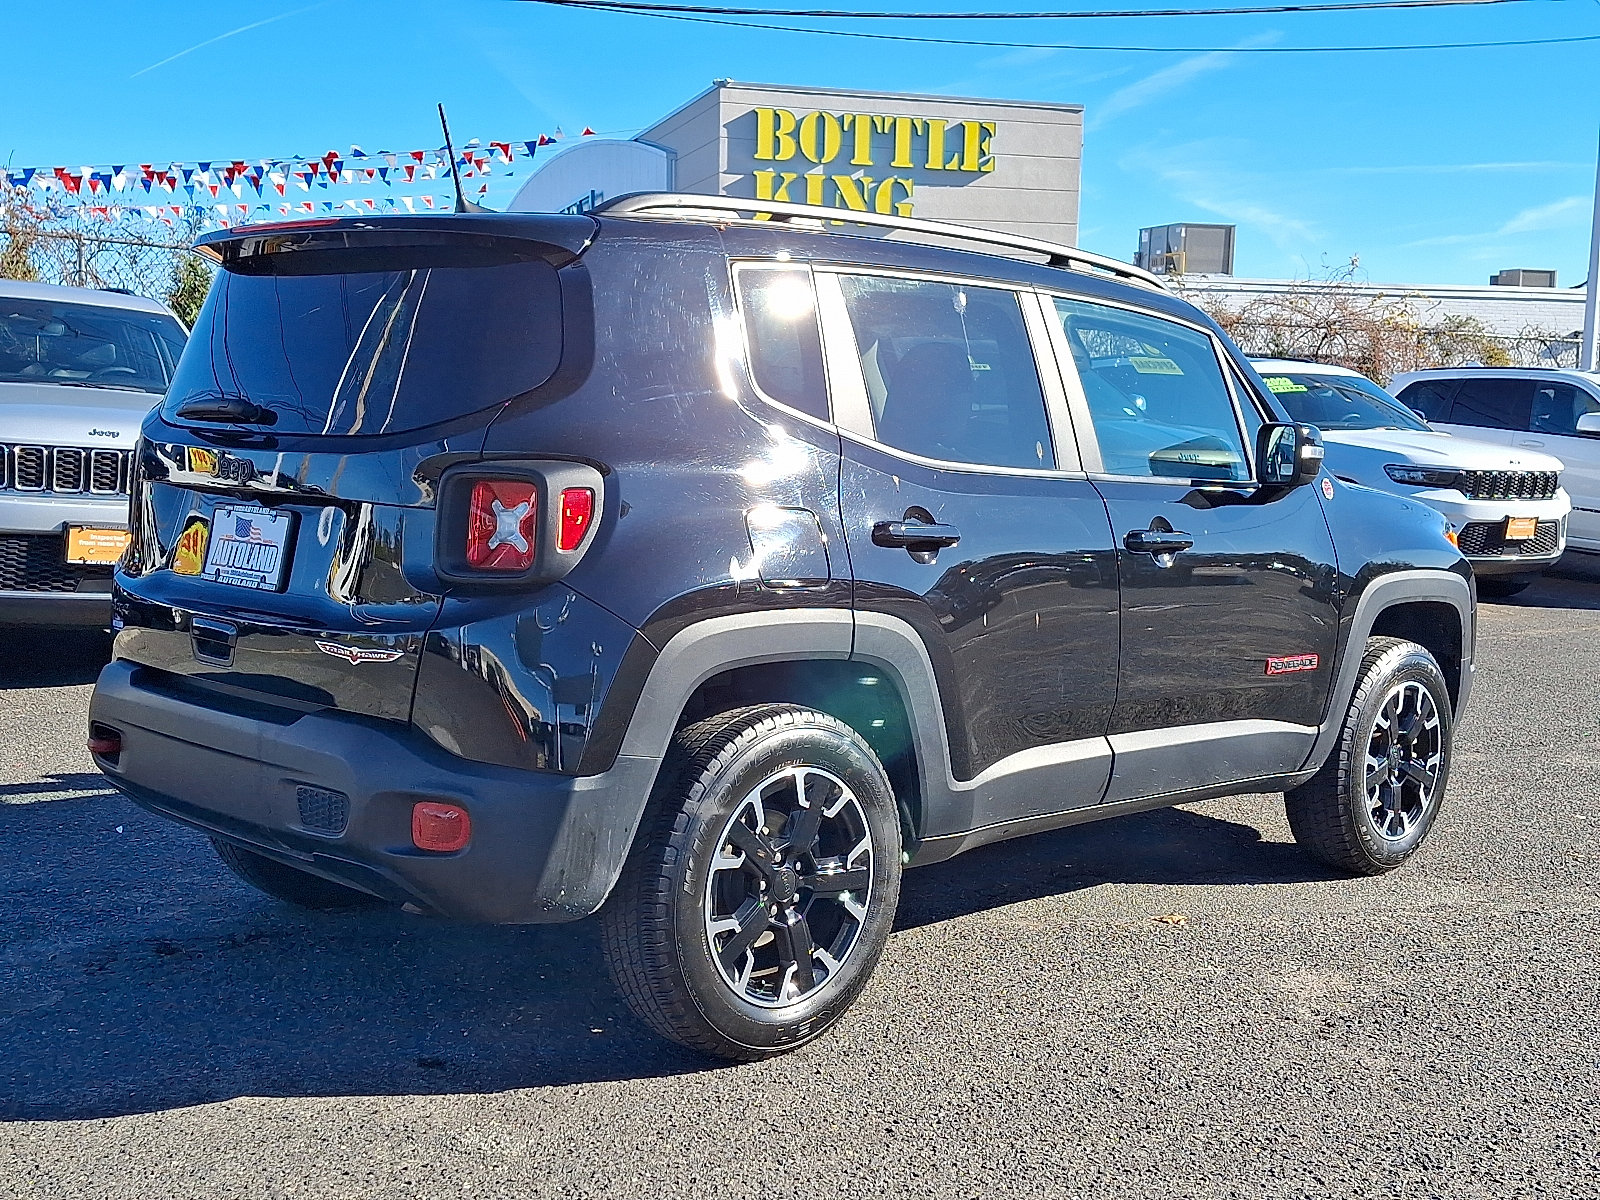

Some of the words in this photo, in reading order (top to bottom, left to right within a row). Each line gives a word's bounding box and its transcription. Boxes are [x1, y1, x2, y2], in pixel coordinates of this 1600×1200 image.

[753, 107, 997, 172] BOTTLE
[753, 170, 915, 227] KING
[88, 429, 119, 438] Jeep
[210, 450, 250, 486] Jeep
[211, 540, 278, 573] AUTOLAND
[218, 575, 258, 588] AUTOLAND
[325, 645, 353, 657] TRAIL
[1271, 658, 1316, 670] RENEGADE
